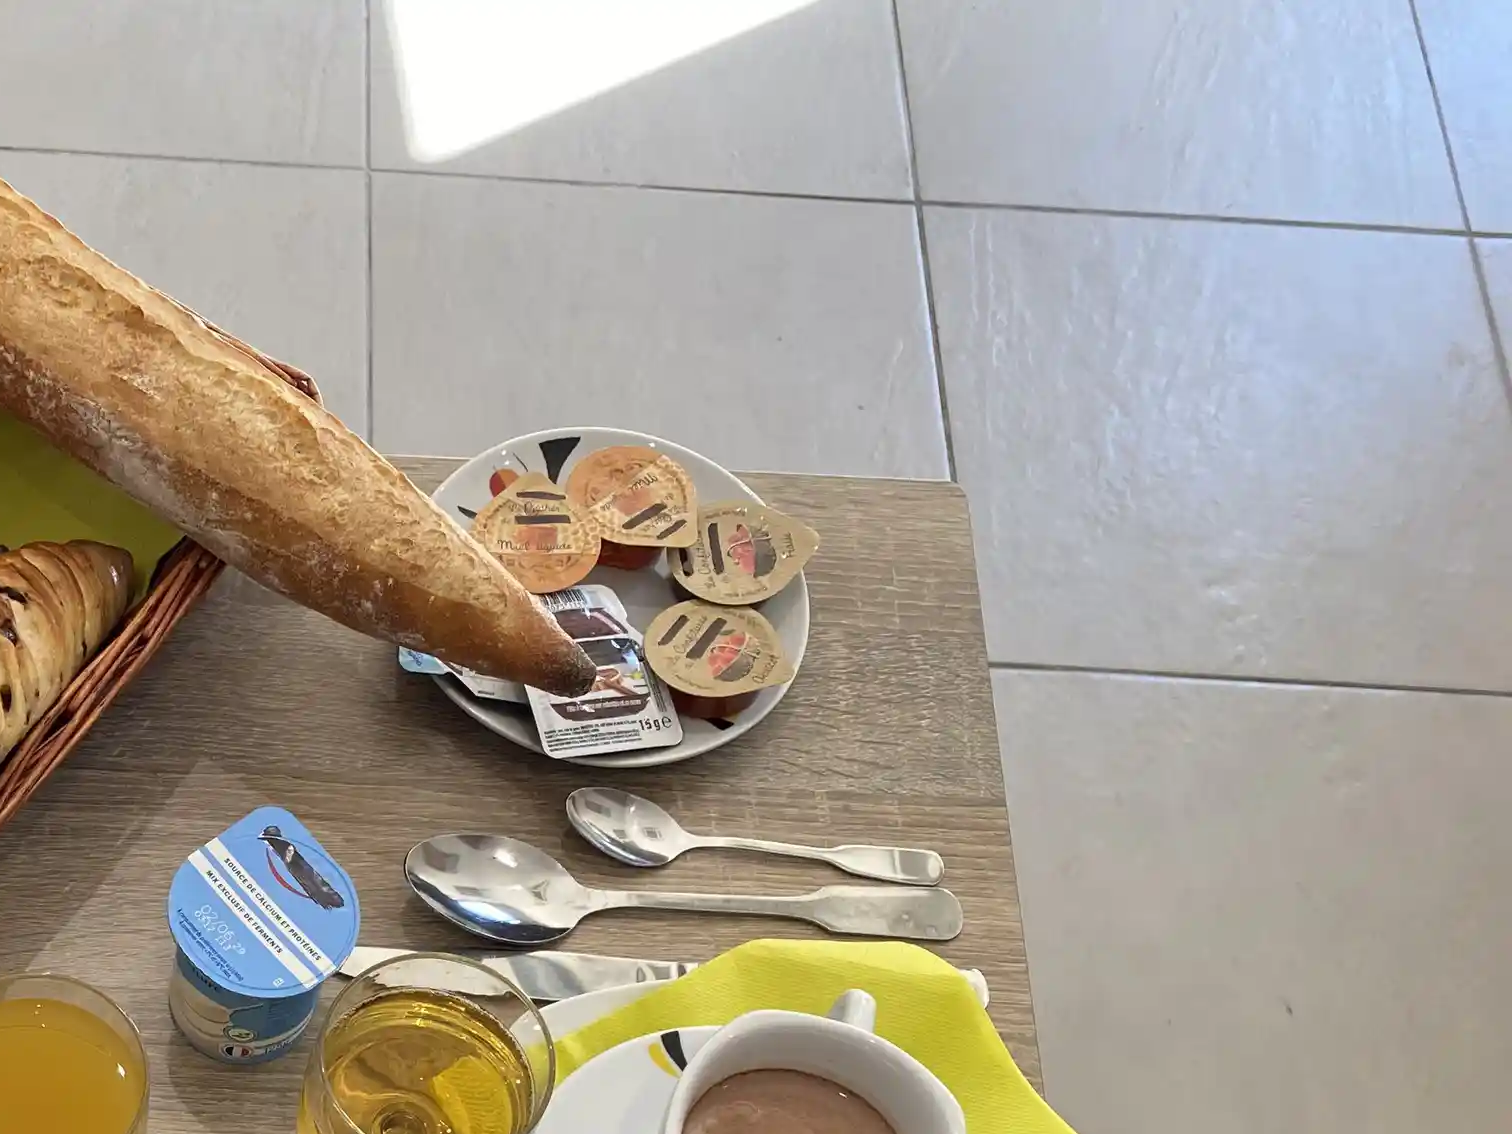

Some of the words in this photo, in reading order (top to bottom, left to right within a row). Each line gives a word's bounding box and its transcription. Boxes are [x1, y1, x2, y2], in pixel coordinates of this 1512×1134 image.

[204, 869, 219, 884] MIX
[216, 882, 246, 914] EXCLUSIF
[242, 912, 254, 923] DE
[250, 920, 283, 954] FERMENTS
[222, 857, 249, 884] SOURCE
[245, 882, 257, 894] DE
[254, 891, 282, 921] CALCIUM
[279, 919, 290, 929] ET
